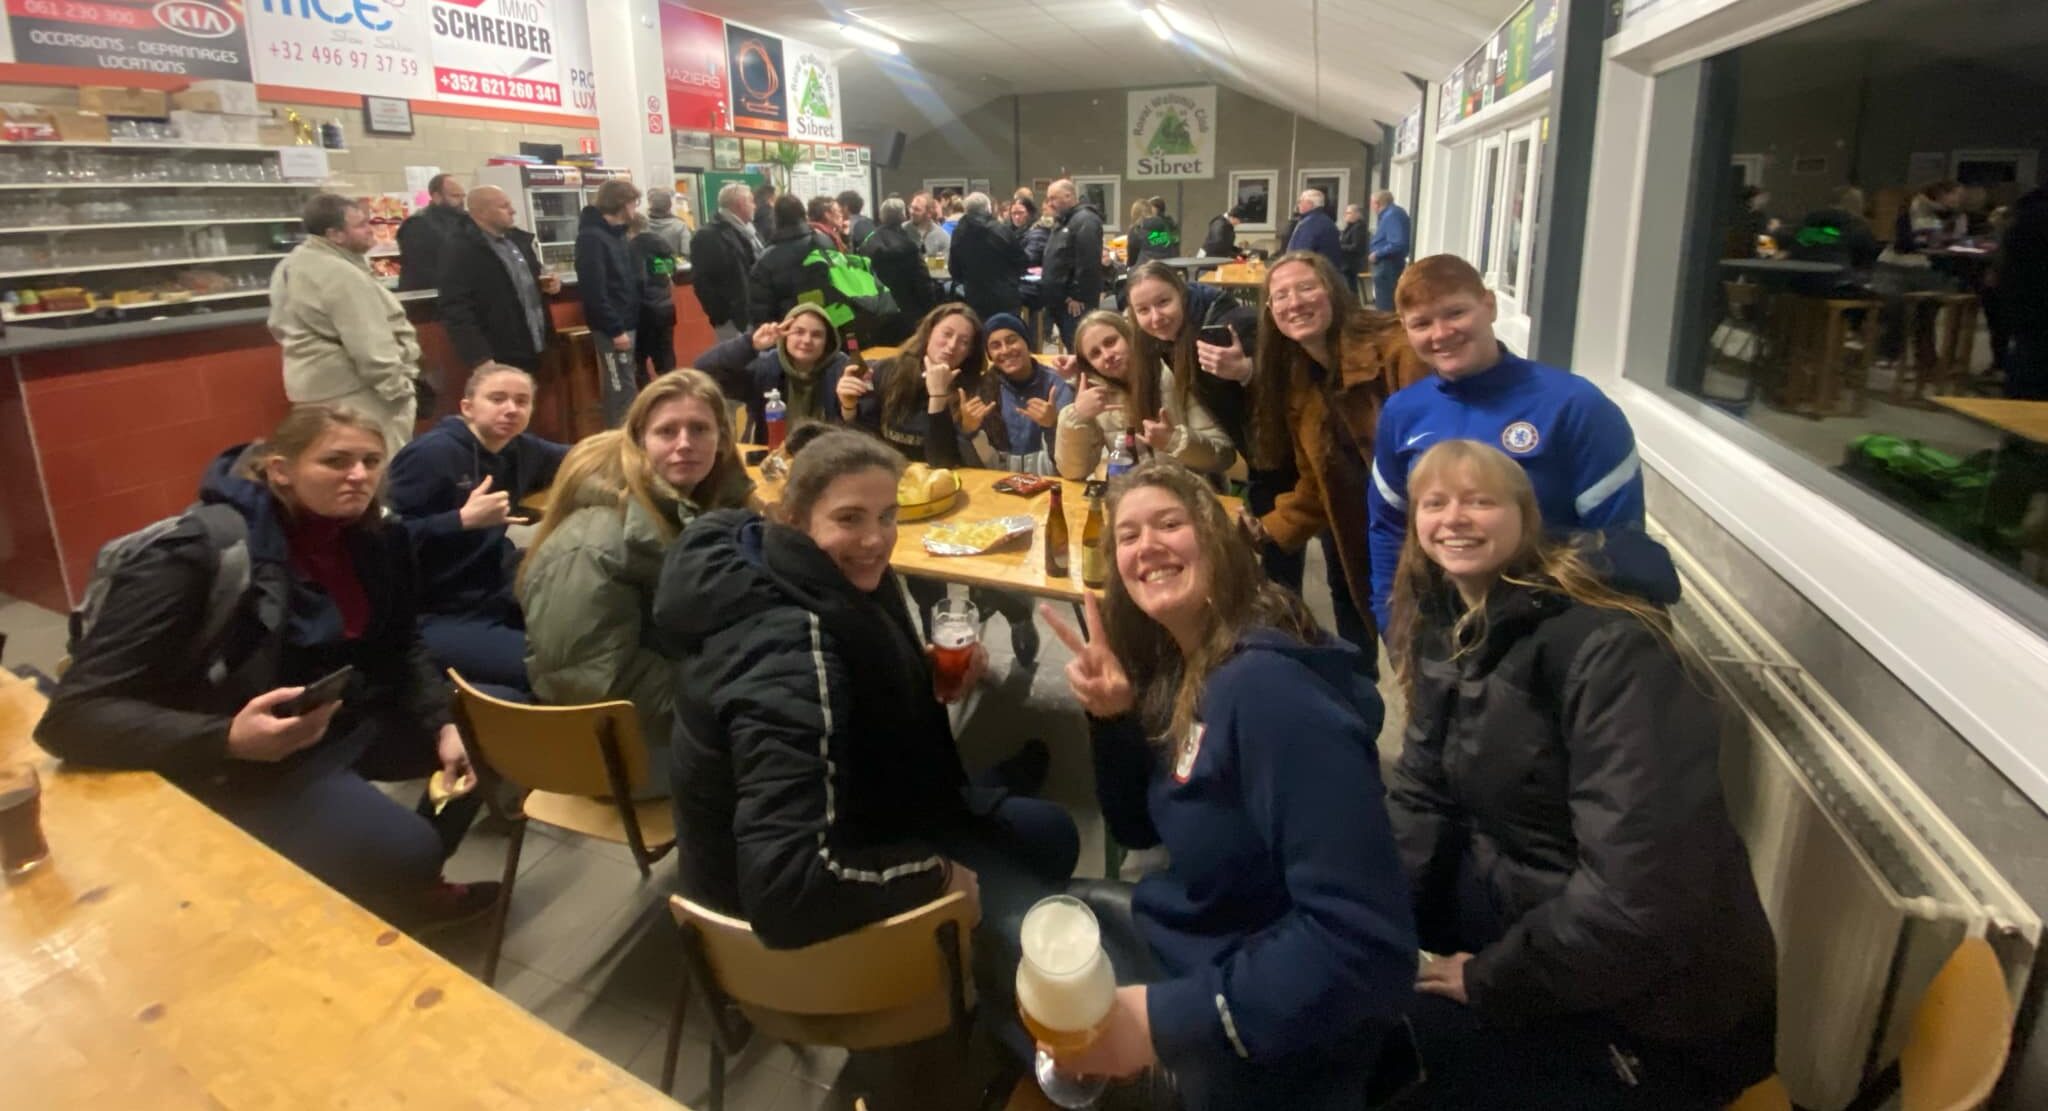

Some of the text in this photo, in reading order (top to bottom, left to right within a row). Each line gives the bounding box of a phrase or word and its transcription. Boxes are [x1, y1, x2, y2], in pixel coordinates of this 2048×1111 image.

[64, 2, 97, 20] 230
[102, 7, 134, 24] 300
[168, 6, 226, 32] KIA
[497, 0, 538, 23] IMMO
[432, 5, 552, 55] SCHREIBER
[29, 30, 125, 51] OCCASIONS
[138, 40, 238, 64] DEPANNAGES
[269, 40, 419, 76] +32 496 97 37 59
[98, 55, 187, 74] LOCATIONS
[440, 72, 558, 103] +352 621 260 341
[572, 89, 598, 112] LUX
[796, 116, 835, 138] Sibret
[1137, 158, 1203, 175] Sibret
